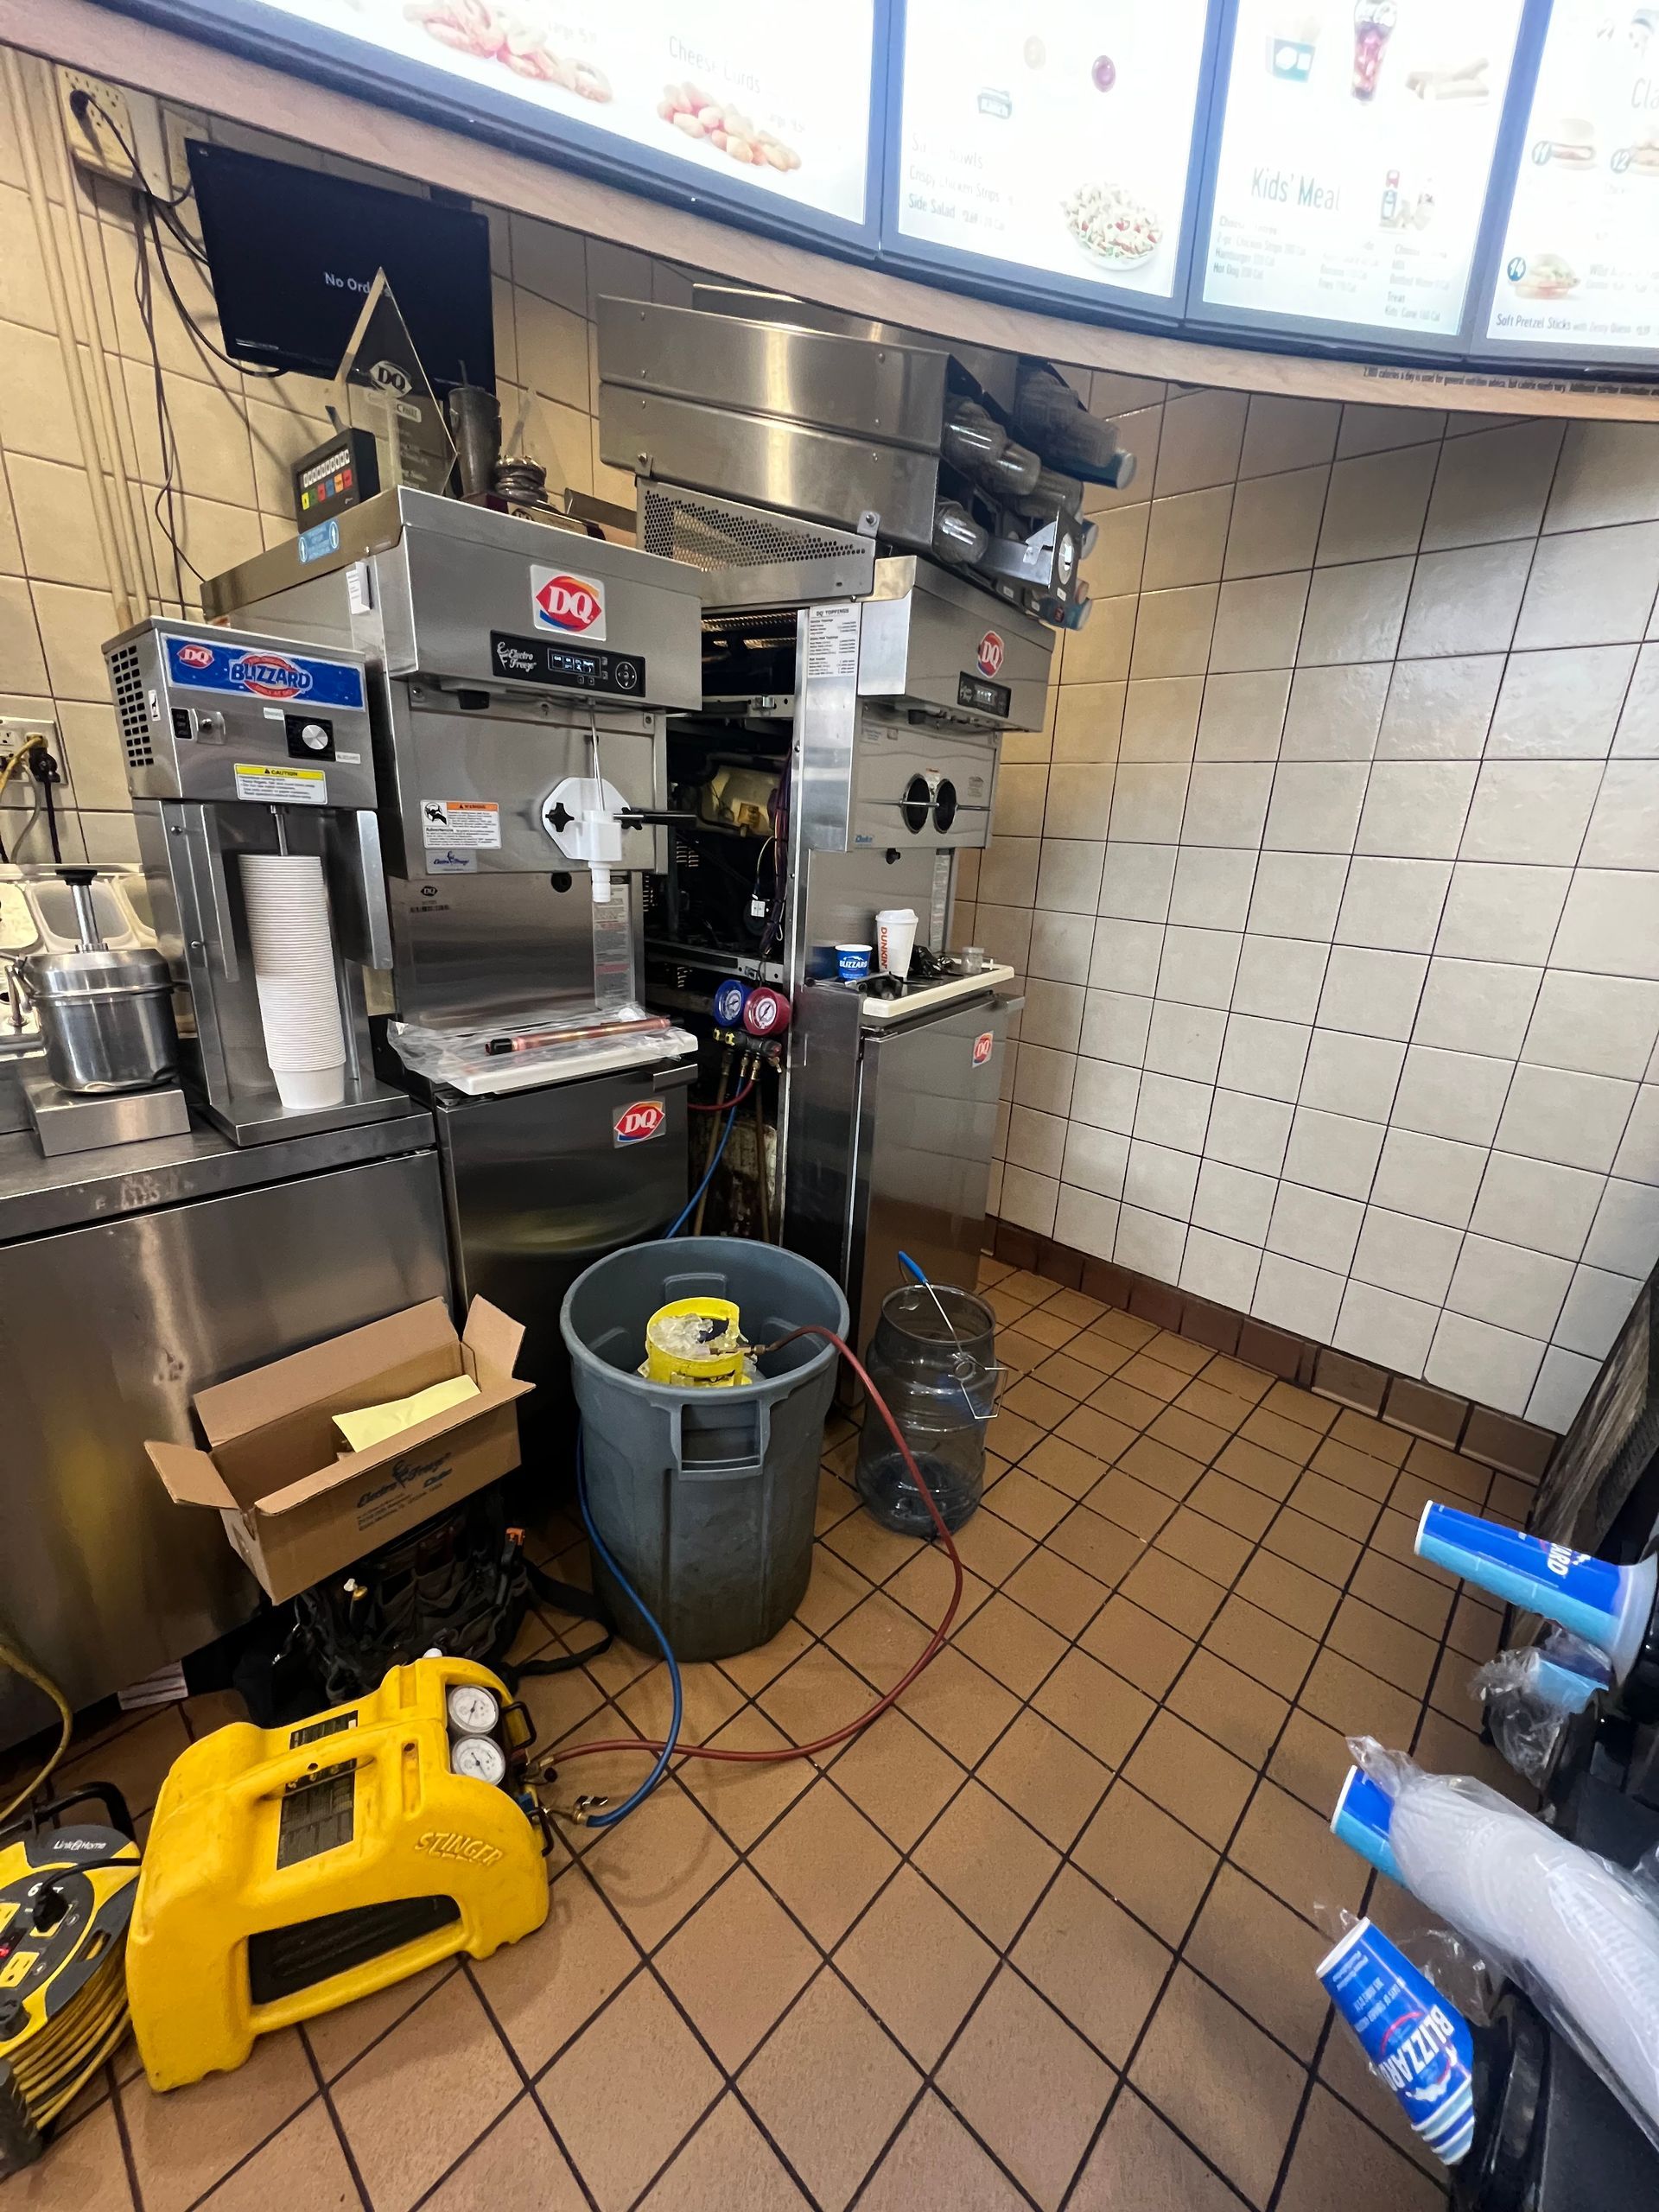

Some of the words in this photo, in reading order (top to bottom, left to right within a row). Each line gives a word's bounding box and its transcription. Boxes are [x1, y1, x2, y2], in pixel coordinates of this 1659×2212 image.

[670, 35, 718, 74] Cheese
[1251, 166, 1294, 202] Kids'
[1297, 175, 1341, 212] Meal
[908, 193, 927, 212] Side
[931, 198, 956, 219] Salad
[325, 271, 344, 288] No
[1496, 313, 1514, 327] Soft
[1516, 315, 1545, 329] Pretzel
[1548, 316, 1572, 331] Sticks
[378, 366, 406, 395] DQ
[548, 585, 593, 625] DQ
[183, 648, 210, 664] DQ
[508, 647, 534, 661] Electro
[509, 659, 537, 673] Freeze
[982, 640, 1000, 671] DQ
[230, 663, 311, 689] BLIZZARD
[976, 1039, 989, 1058] DQ
[624, 1109, 658, 1134] DQ
[414, 1832, 503, 1867] STINGER
